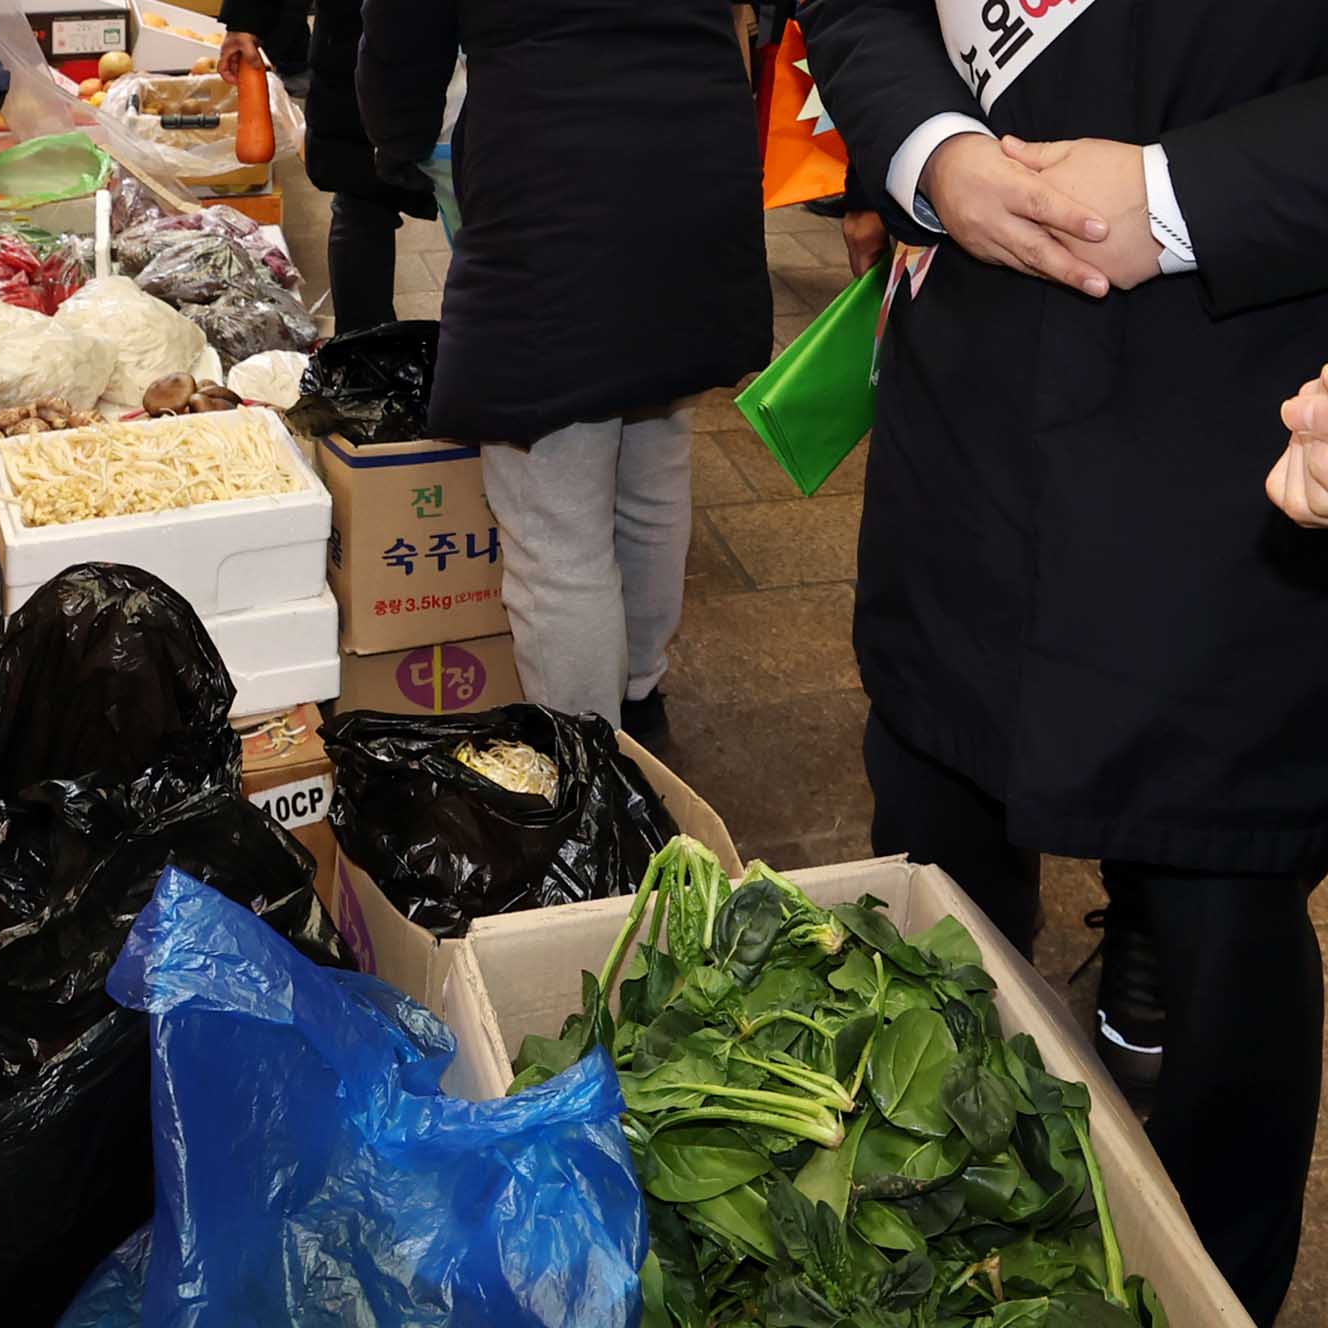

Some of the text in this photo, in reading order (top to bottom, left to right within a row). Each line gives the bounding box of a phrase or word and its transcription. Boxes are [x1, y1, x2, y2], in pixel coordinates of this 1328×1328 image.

[410, 484, 446, 519] 전
[381, 527, 502, 576] 숙주나
[373, 598, 402, 616] 중량
[404, 594, 453, 613] 3.5kg
